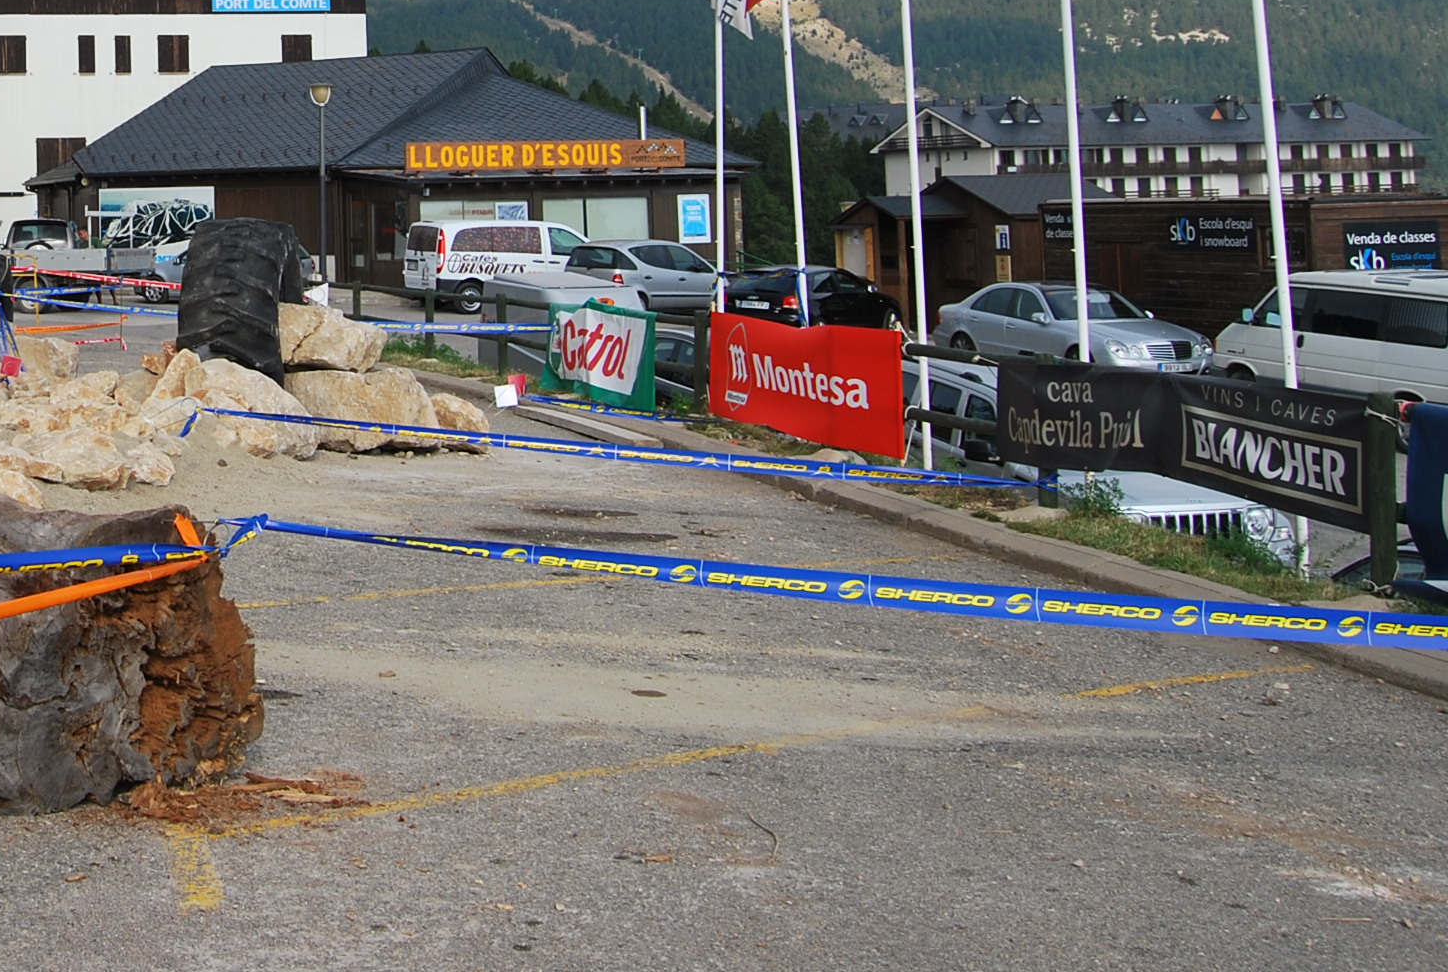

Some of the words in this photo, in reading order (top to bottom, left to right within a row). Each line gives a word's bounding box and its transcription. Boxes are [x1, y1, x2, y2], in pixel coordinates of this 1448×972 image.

[409, 144, 515, 168] LLOGUER
[522, 142, 623, 166] D'ESQUIS
[1044, 214, 1064, 224] Venda
[1198, 218, 1224, 229] Escola
[1045, 228, 1054, 238] de
[1054, 228, 1074, 238] classe
[1204, 236, 1248, 248] snowboard
[1346, 232, 1382, 246] Venda
[1382, 231, 1398, 244] de
[1398, 230, 1436, 244] classes
[1391, 252, 1412, 261] Escola
[458, 262, 526, 276] BUSQUETS
[752, 352, 870, 410] Montesa
[726, 392, 746, 403] Montesa
[1046, 381, 1094, 404] cava
[1202, 384, 1244, 408] VINS
[1270, 398, 1336, 427] CAVES
[1008, 406, 1093, 454] Capdevila
[508, 440, 580, 453] SHERCO
[619, 450, 694, 464] SHERCO
[732, 460, 808, 472] SHERCO
[848, 468, 922, 481] SHERCO
[1192, 418, 1346, 496] BLANCHER
[538, 554, 660, 578] SHERCO
[706, 572, 828, 594] SHERCO
[874, 586, 995, 608] SHERCO
[1042, 600, 1162, 620] SHERCO
[1208, 611, 1328, 632] SHERCO
